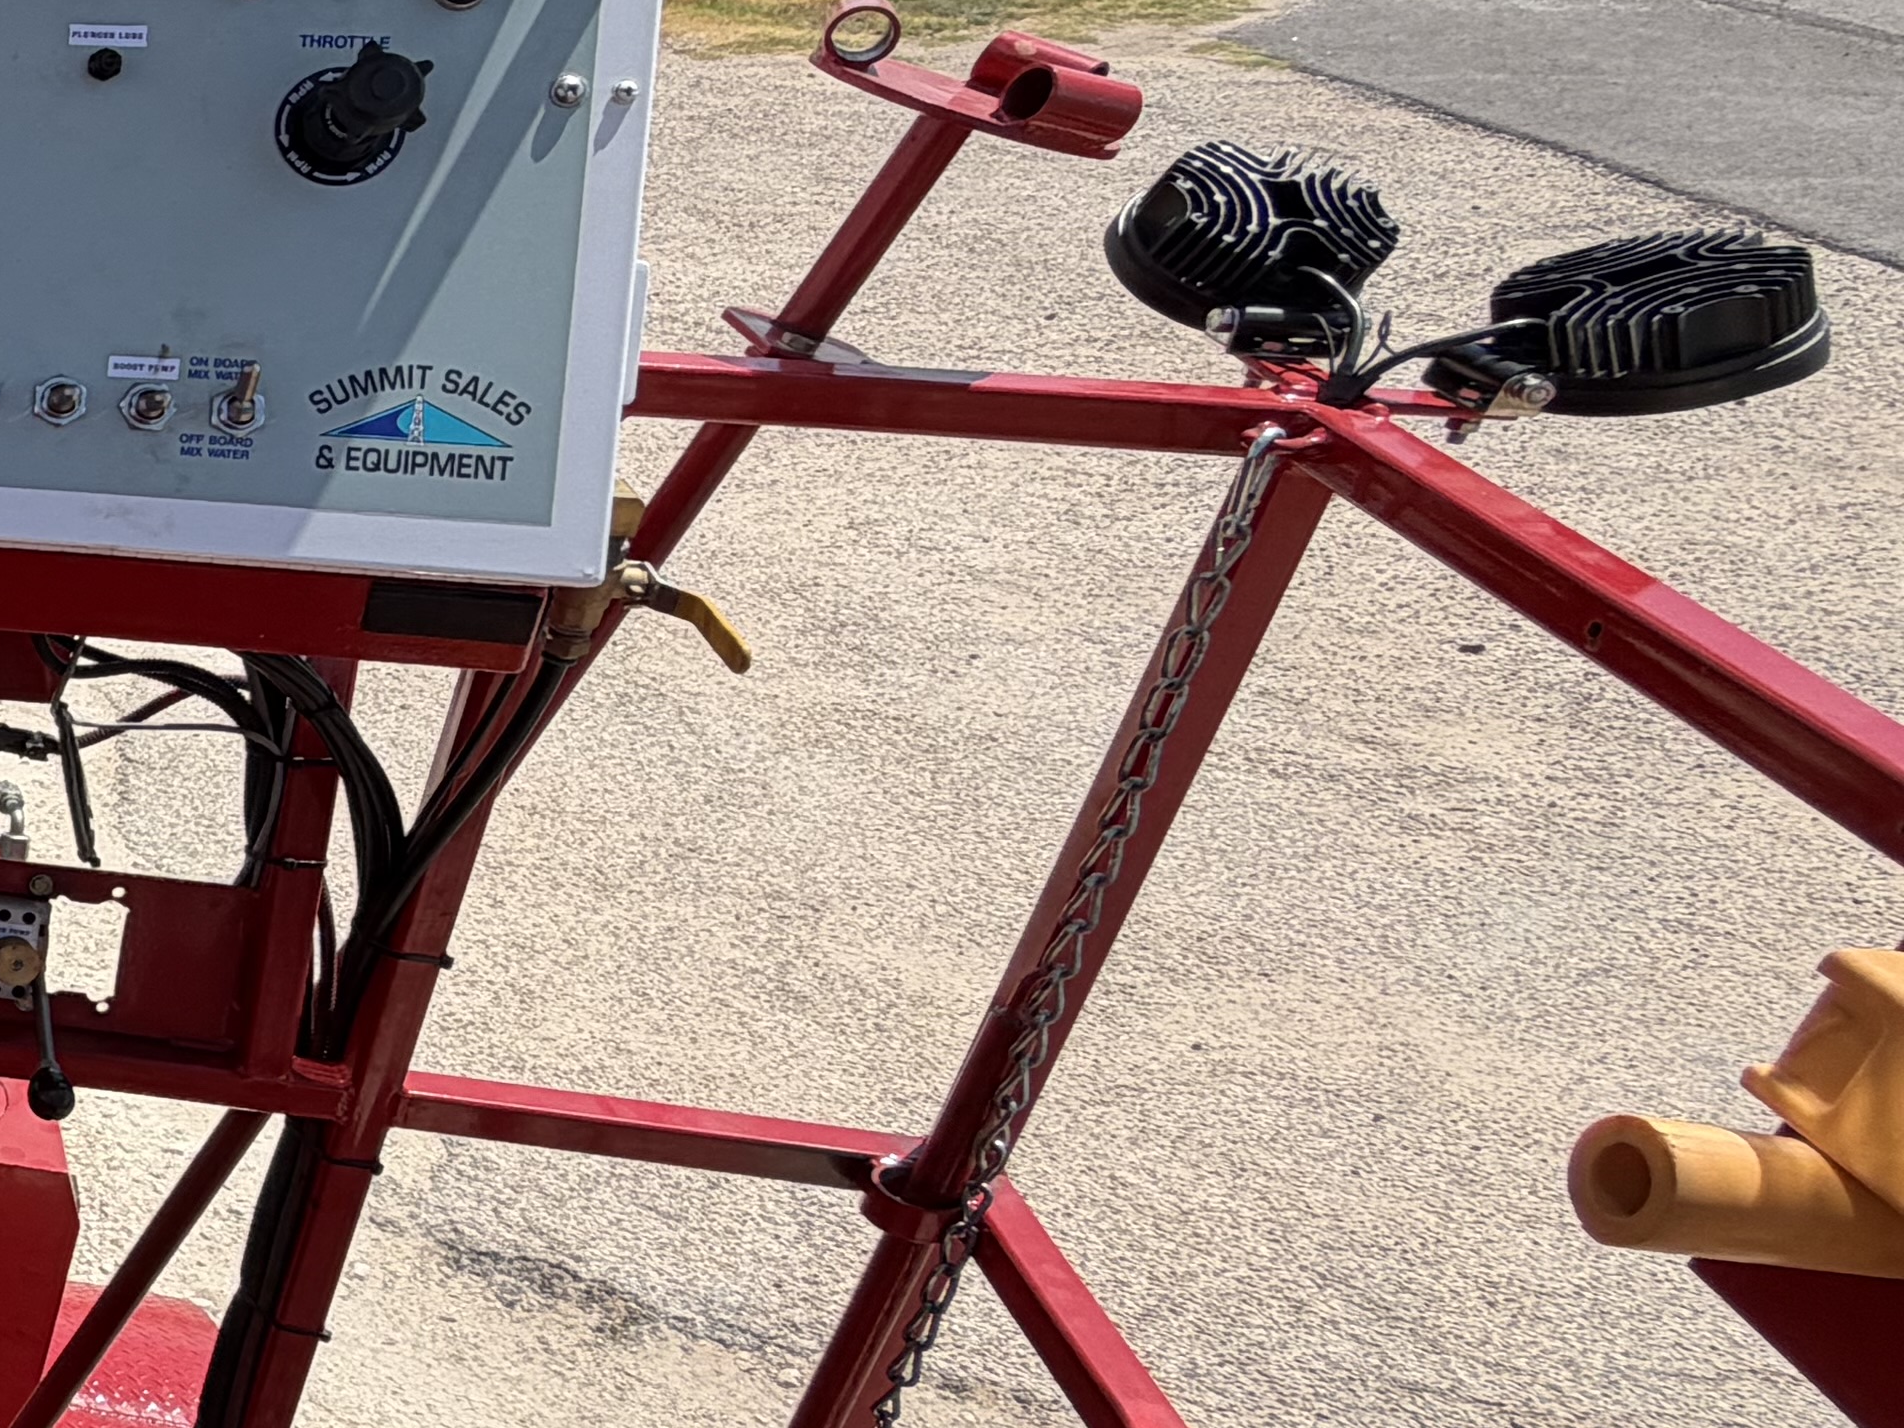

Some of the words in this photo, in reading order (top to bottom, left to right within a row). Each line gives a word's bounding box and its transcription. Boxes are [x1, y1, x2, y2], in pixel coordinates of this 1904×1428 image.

[113, 362, 145, 371] BOOST
[190, 356, 208, 366] ON
[188, 369, 209, 379] MIX
[308, 364, 433, 415] SUMMIT
[441, 368, 532, 426] SALES
[179, 433, 204, 444] OFF
[208, 434, 254, 448] BOARD
[180, 447, 202, 457] MIX
[208, 447, 249, 460] WATER
[315, 444, 335, 470] &
[345, 446, 514, 481] EQUIPMENT
